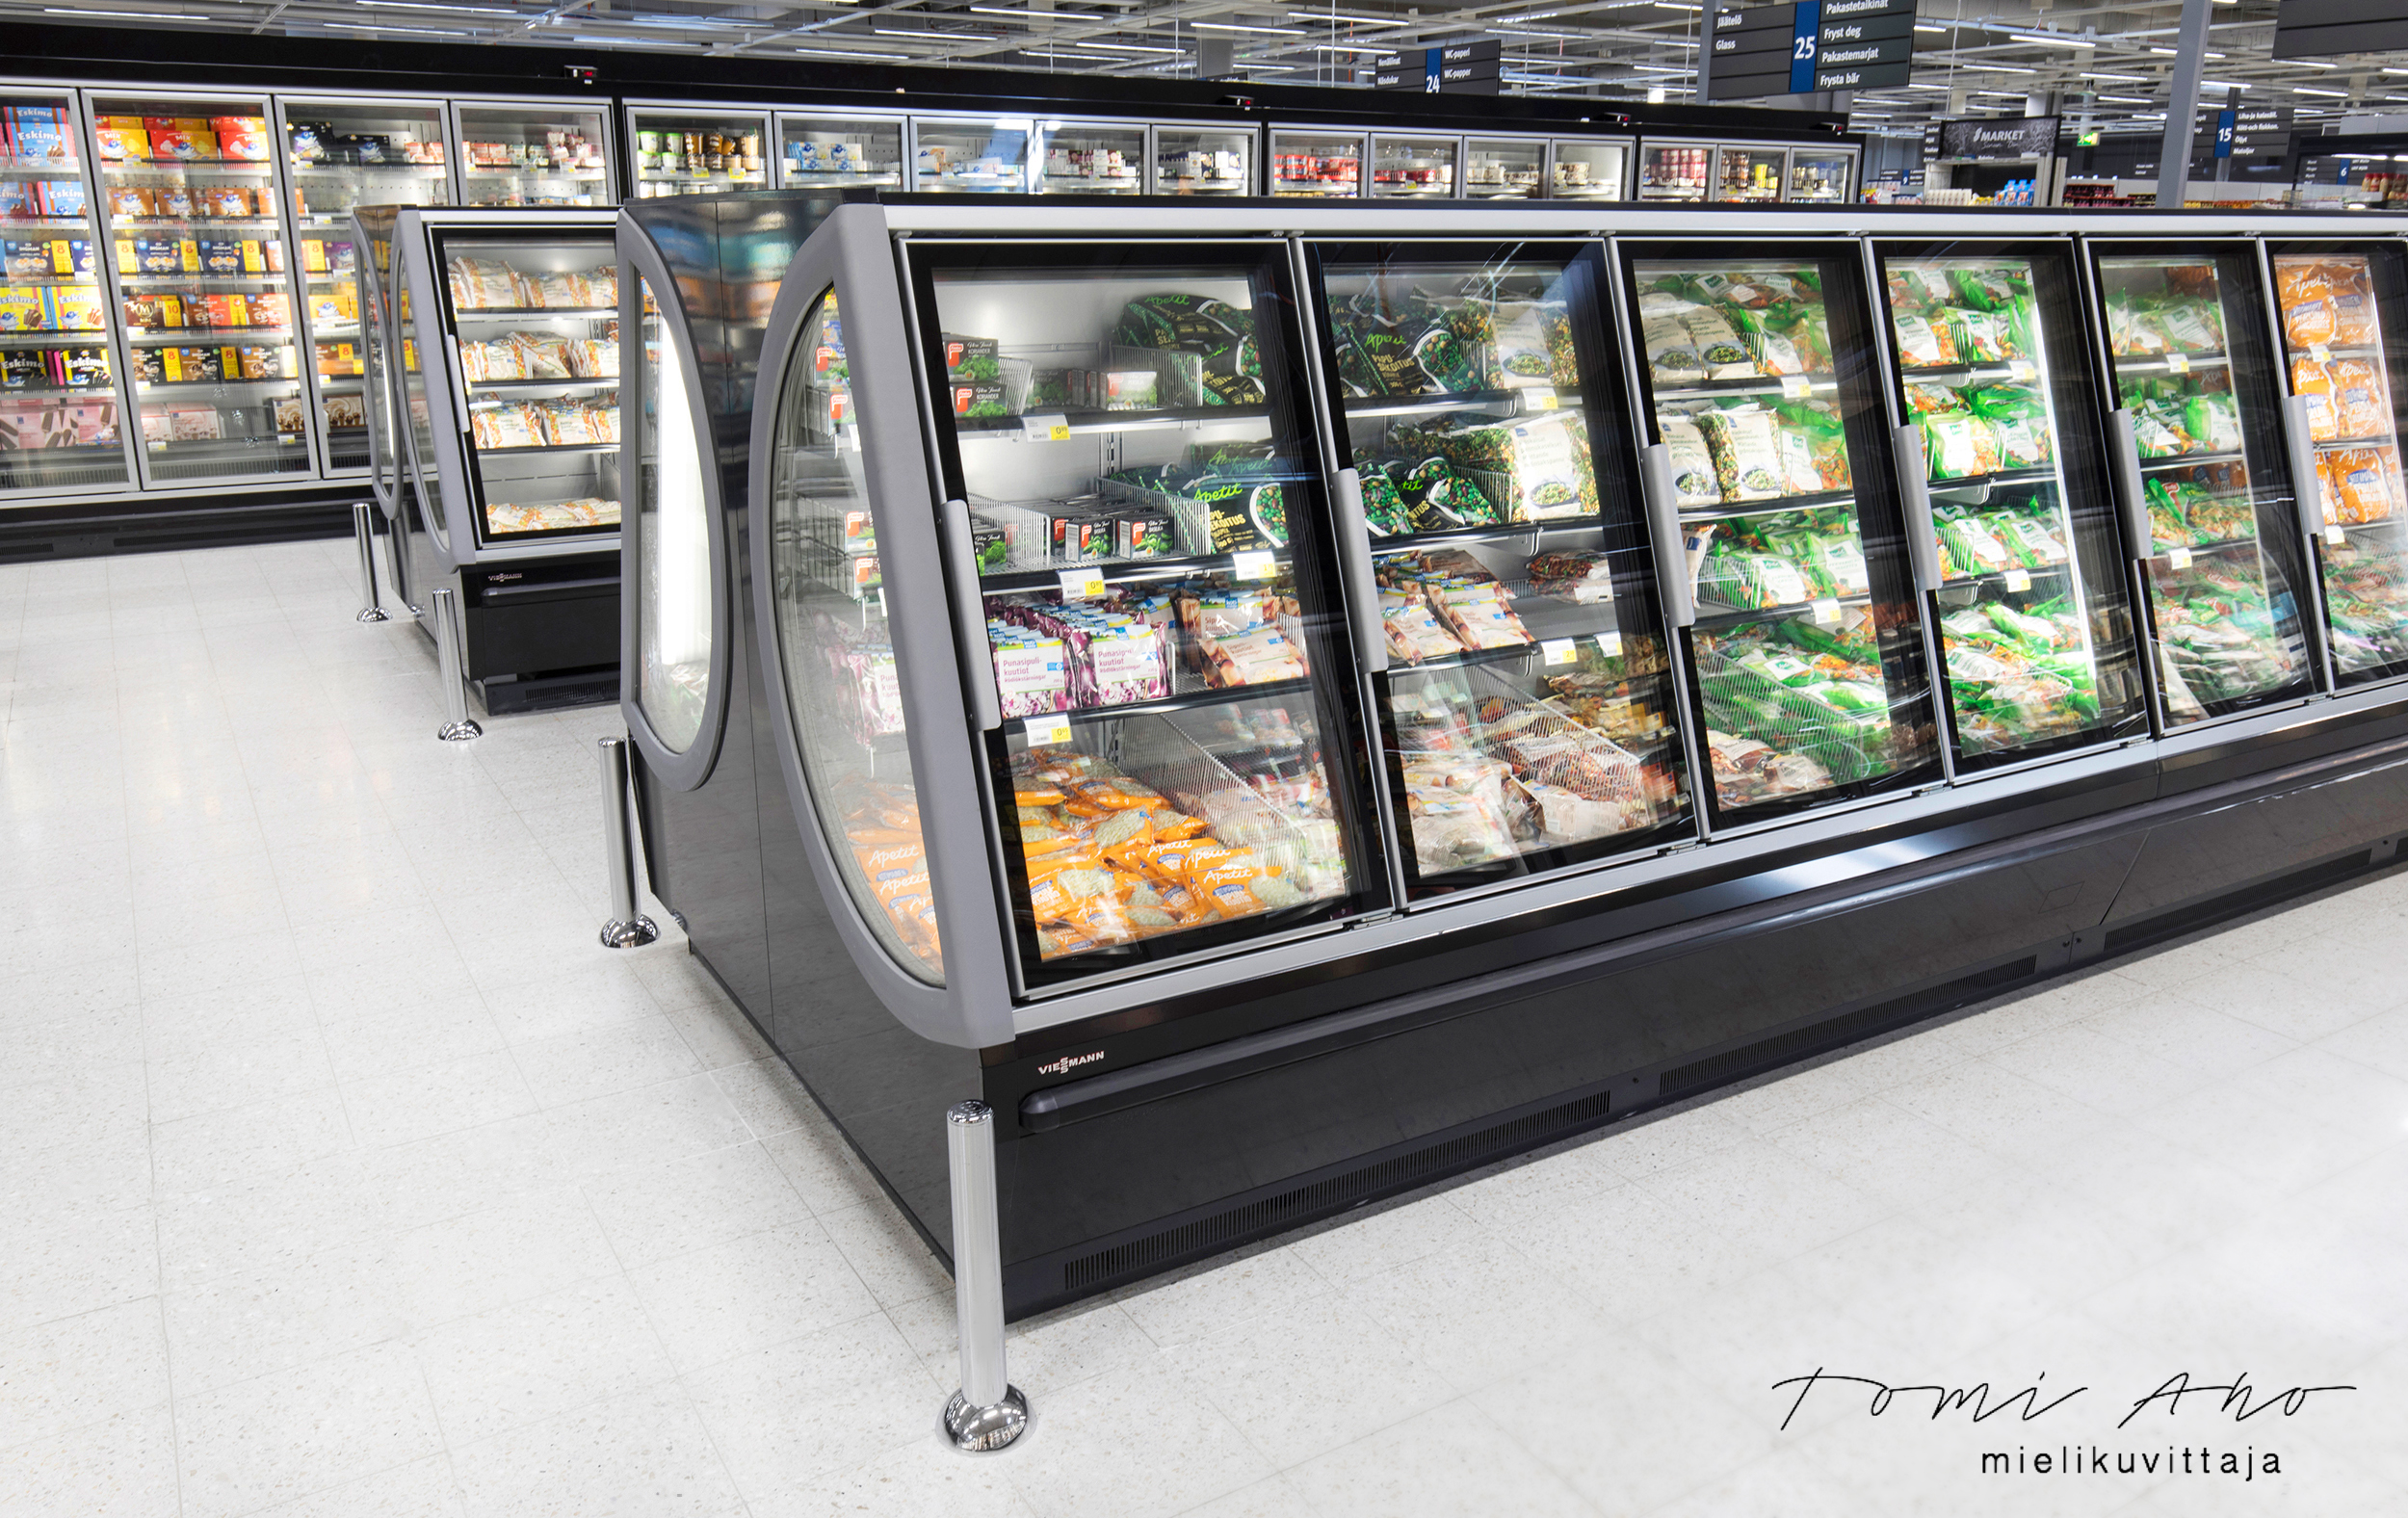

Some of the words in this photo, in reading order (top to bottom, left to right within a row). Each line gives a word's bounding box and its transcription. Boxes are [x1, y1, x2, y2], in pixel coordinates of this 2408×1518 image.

[1717, 14, 1742, 29] Jäätelö
[1824, 28, 1844, 40] Fryst
[1845, 25, 1862, 39] deg
[1715, 39, 1736, 51] Glass
[1794, 36, 1816, 60] 25
[1821, 47, 1879, 64] Pakastemarjat
[1426, 74, 1441, 93] 24
[1819, 73, 1845, 89] Frysta
[1846, 72, 1860, 84] bär
[17, 130, 62, 142] Eskimo
[2218, 127, 2232, 143] 15
[2340, 167, 2347, 177] 6
[49, 188, 85, 199] Eskim
[57, 245, 65, 254] 8
[121, 244, 130, 253] 8
[247, 244, 255, 253] 8
[168, 304, 179, 315] 10
[168, 352, 175, 360] 8
[342, 347, 350, 355] 8
[2, 358, 45, 369] Eskimo
[65, 357, 110, 370] Eskimo
[1193, 483, 1243, 503] Apetit
[1003, 657, 1042, 667] Punasipuli-
[1098, 658, 1125, 667] kuutiot
[1147, 840, 1192, 857] Apetit
[869, 844, 919, 868] Apetit
[1203, 869, 1253, 884] Apetit
[879, 872, 929, 895] Apetit
[1037, 1050, 1105, 1075] VIESSMANN
